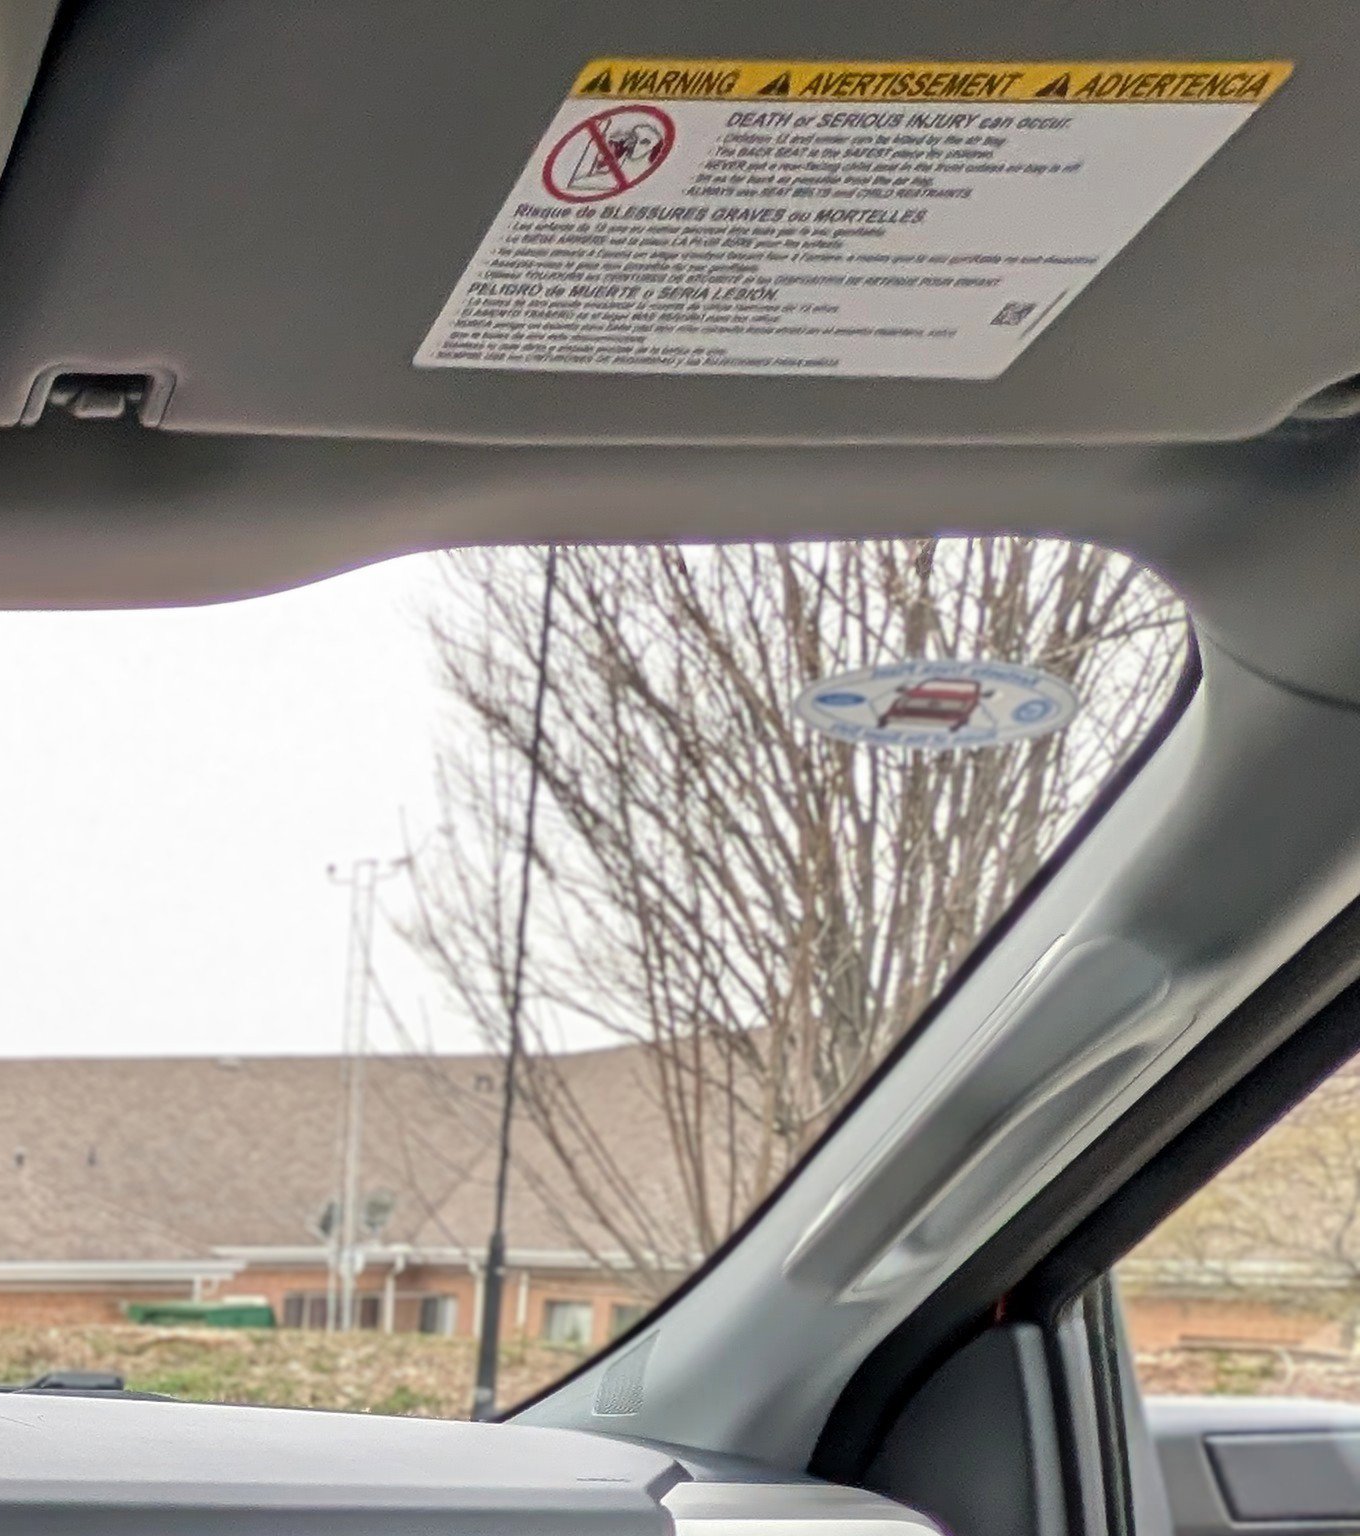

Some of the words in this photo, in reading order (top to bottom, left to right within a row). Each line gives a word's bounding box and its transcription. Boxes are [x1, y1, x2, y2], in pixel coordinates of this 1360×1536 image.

[617, 68, 742, 95] WARNING
[800, 70, 1025, 98] AVERTISSEMENT
[1074, 71, 1271, 98] ADVERTENCIA
[726, 112, 793, 128] DEATH
[793, 115, 816, 128] or
[817, 112, 904, 129] SERIOUS
[905, 113, 980, 129] INJURY
[979, 117, 1014, 130] can
[513, 203, 572, 222] Risque
[600, 205, 708, 221] BLESSURES
[711, 207, 787, 222] GRAVES
[788, 211, 812, 222] ou
[569, 285, 640, 299] MUERTE
